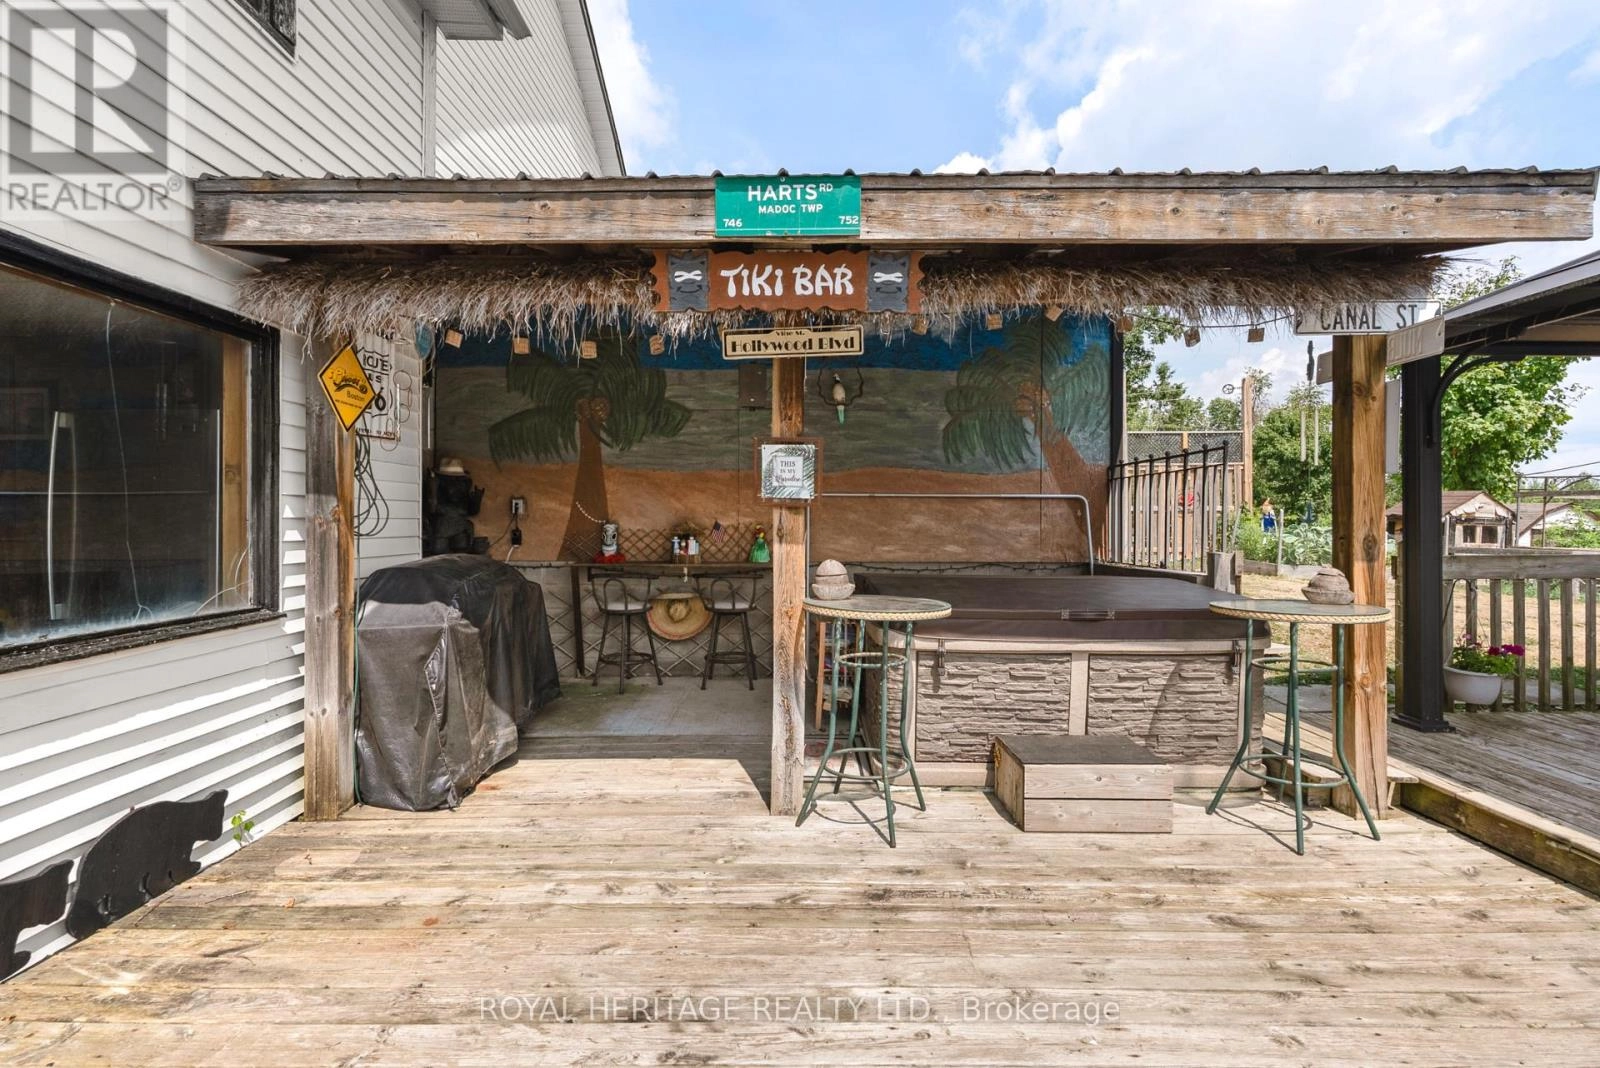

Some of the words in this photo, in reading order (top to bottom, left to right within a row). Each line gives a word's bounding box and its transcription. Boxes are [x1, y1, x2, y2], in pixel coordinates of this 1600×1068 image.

[747, 184, 817, 202] HARTS
[819, 183, 833, 192] RD
[758, 205, 796, 214] MADOC
[801, 204, 823, 213] TWP
[723, 218, 742, 227] 746
[839, 216, 859, 225] 752
[720, 263, 783, 298] TIKI
[792, 263, 854, 296] BAR
[1320, 302, 1381, 330] CANAL
[1396, 304, 1418, 329] ST
[731, 338, 813, 352] Hollywood
[818, 336, 855, 350] Blvd
